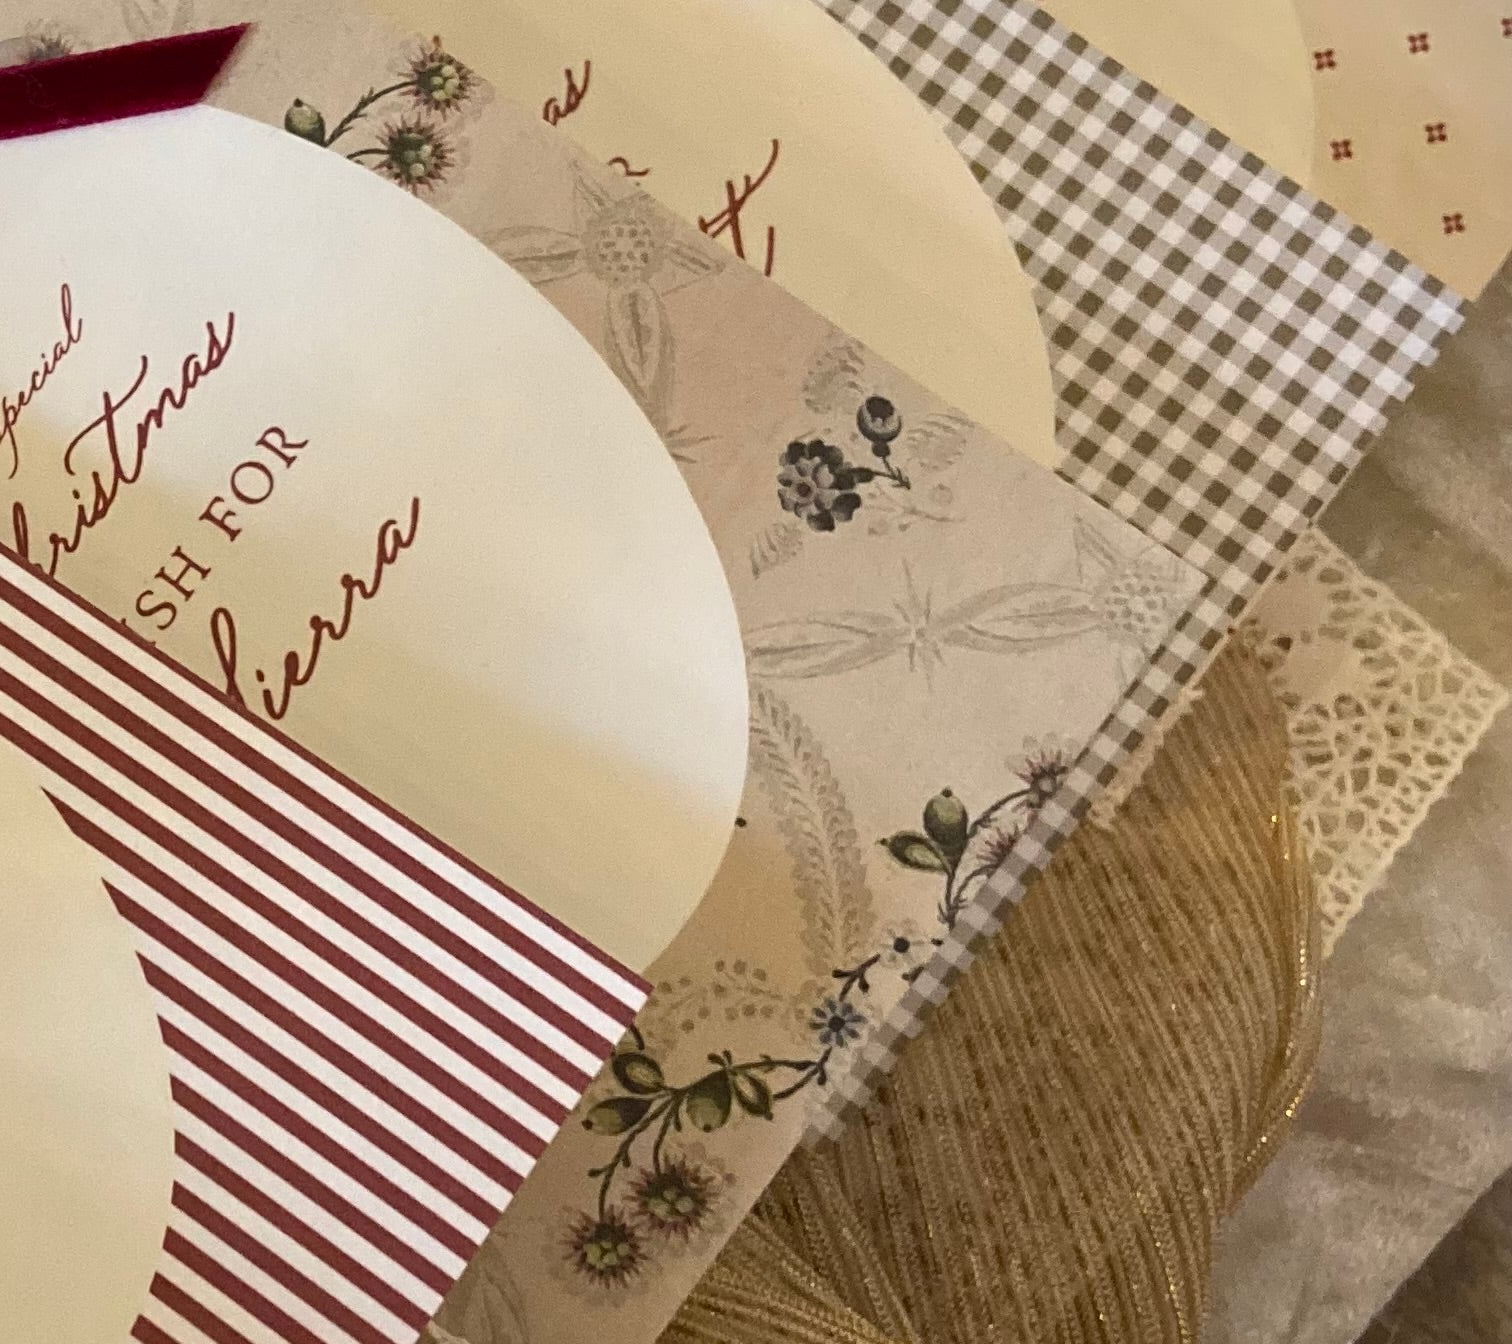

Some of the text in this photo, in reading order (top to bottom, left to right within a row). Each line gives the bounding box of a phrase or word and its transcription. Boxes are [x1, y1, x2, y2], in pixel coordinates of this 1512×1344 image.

[12, 311, 236, 581] hristmas
[126, 424, 310, 636] SH FOR
